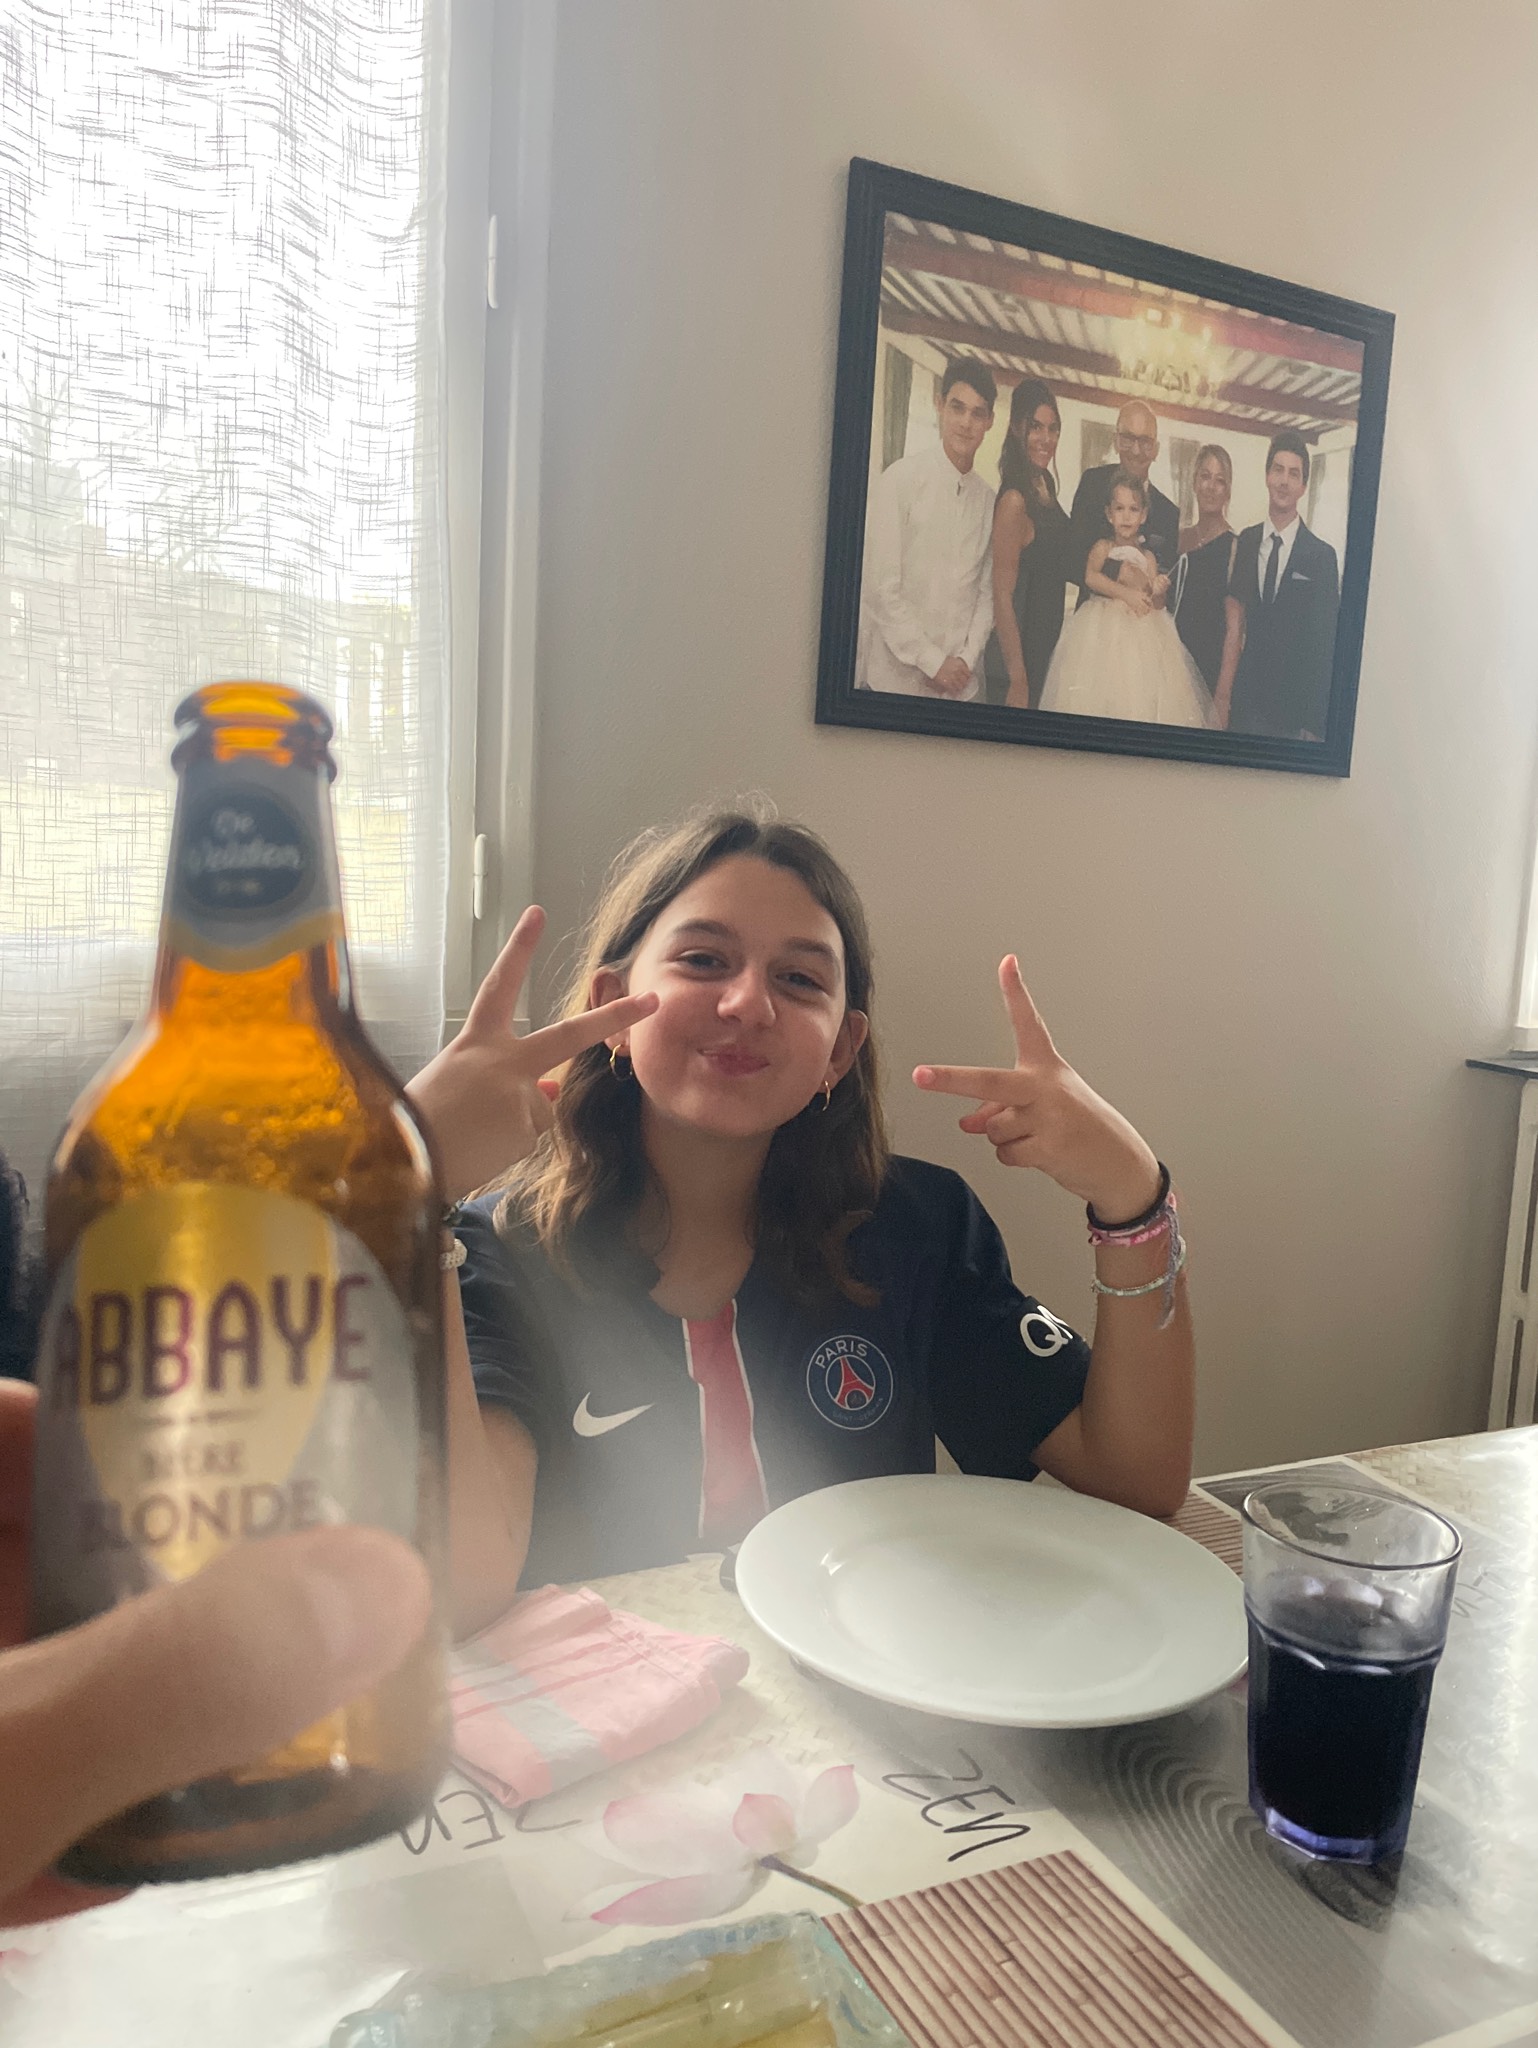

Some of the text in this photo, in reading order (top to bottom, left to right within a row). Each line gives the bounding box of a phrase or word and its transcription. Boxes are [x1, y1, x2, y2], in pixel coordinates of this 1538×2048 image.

[49, 1272, 372, 1408] ABBAYE
[815, 1340, 868, 1369] PARIS
[882, 1748, 1031, 1862] ZEN
